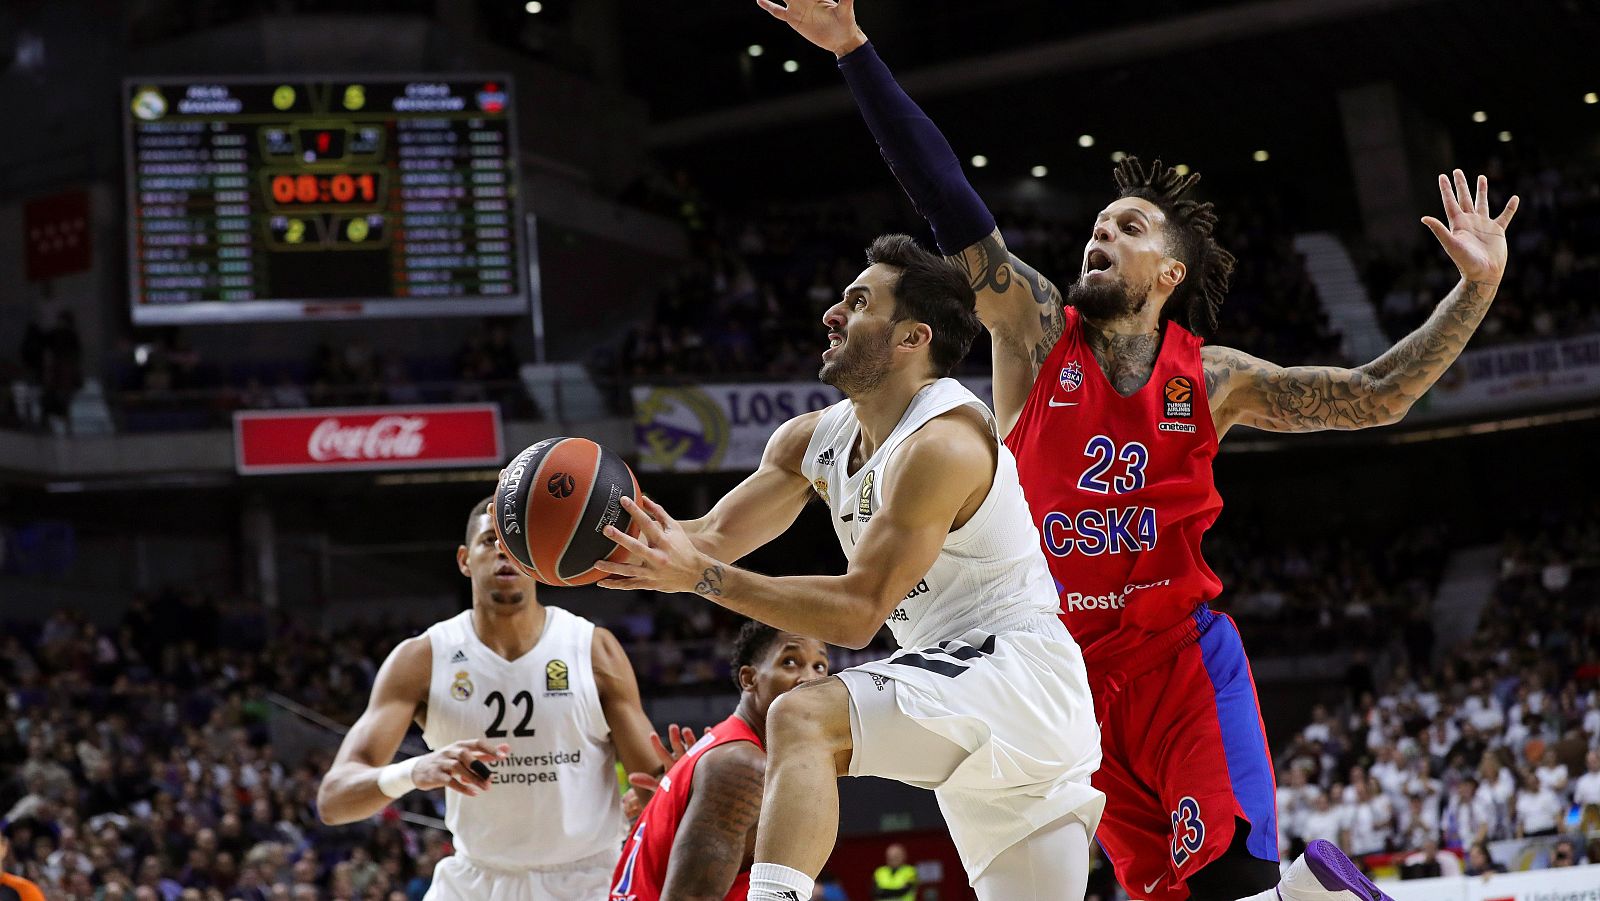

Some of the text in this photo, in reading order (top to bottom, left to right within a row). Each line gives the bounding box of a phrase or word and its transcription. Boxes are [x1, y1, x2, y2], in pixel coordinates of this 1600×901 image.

[272, 174, 375, 203] 08:01
[1062, 371, 1080, 382] CSKA
[728, 391, 796, 426] LOS
[1159, 422, 1196, 432] oneteam
[1077, 435, 1148, 494] 23
[1043, 506, 1157, 557] CSKA
[484, 691, 535, 738] 22
[490, 771, 558, 786] Europea
[1171, 796, 1205, 868] 23
